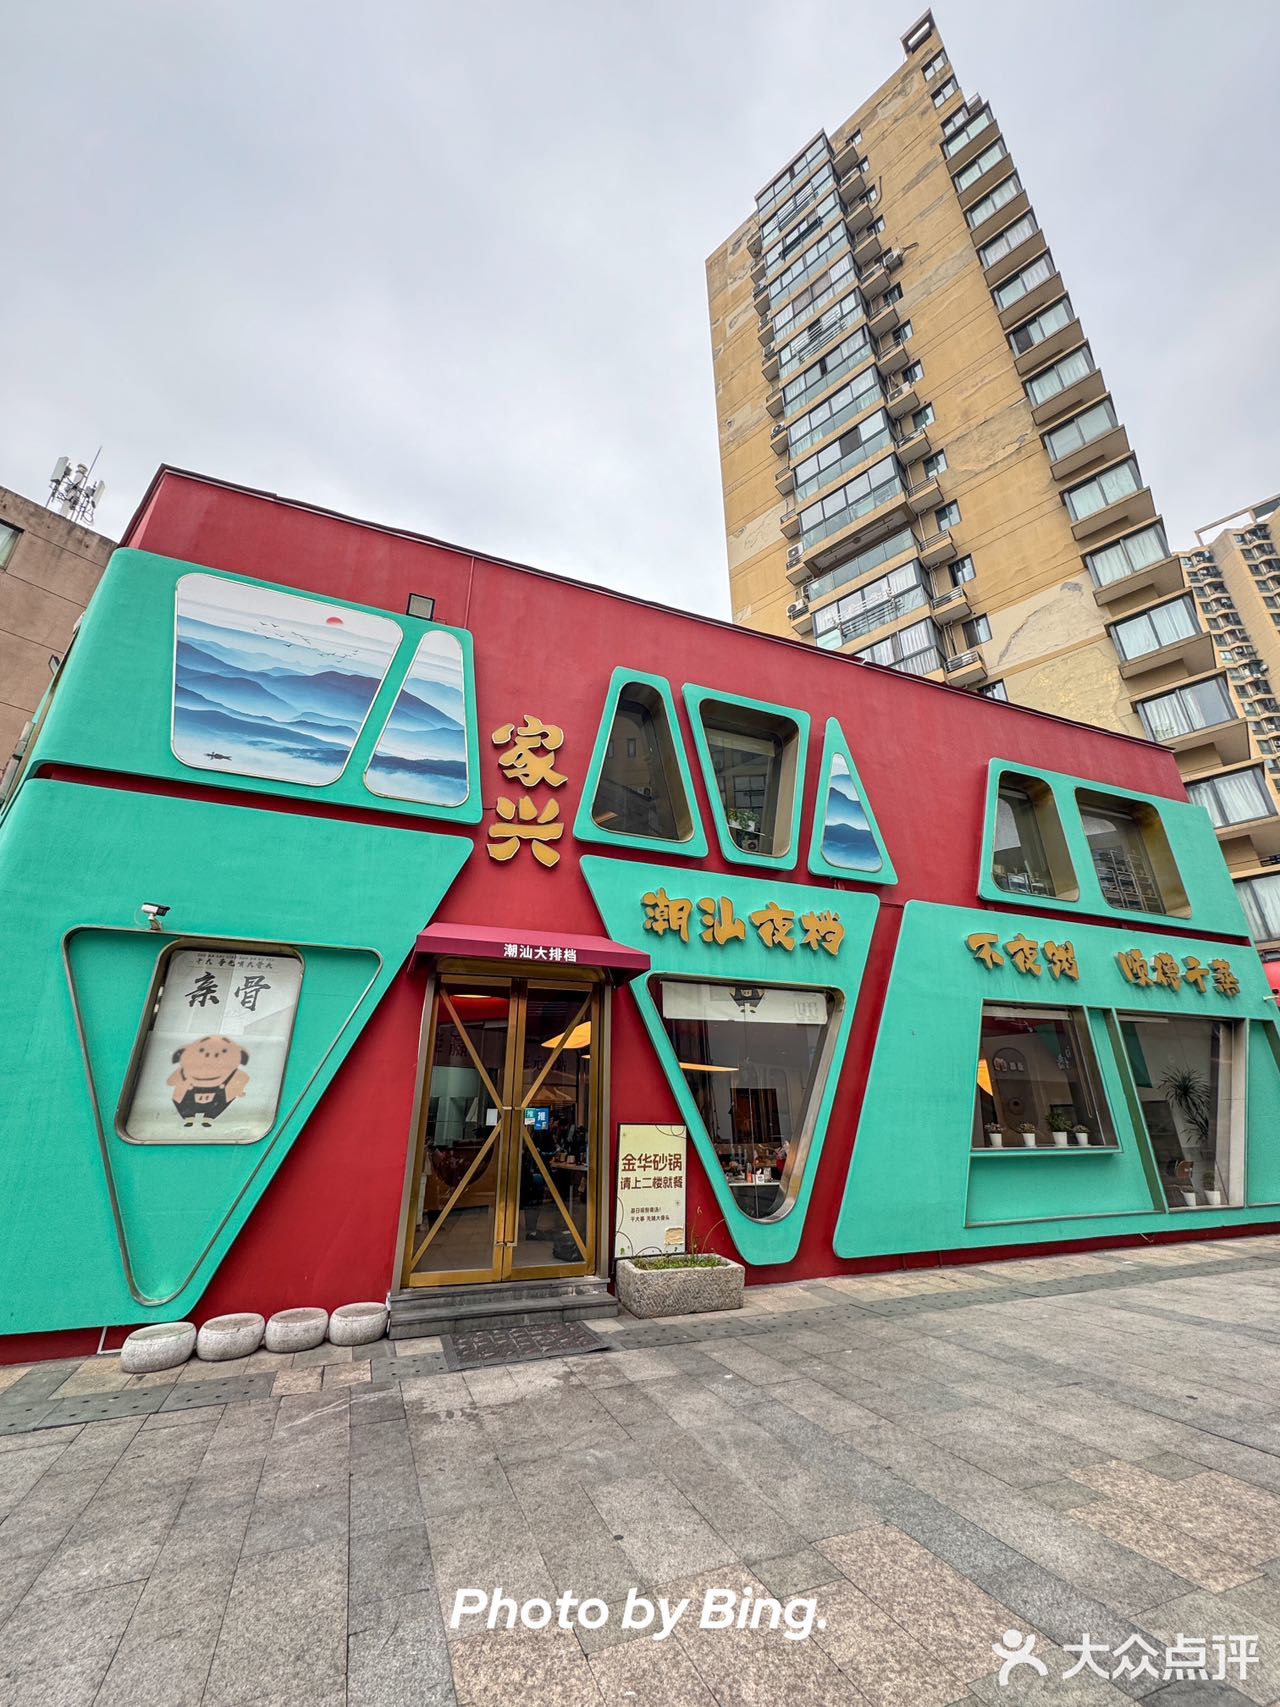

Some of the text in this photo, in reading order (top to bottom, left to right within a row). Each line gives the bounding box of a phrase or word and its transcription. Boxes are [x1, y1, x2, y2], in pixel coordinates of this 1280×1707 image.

[487, 713, 569, 868] 家兴
[640, 887, 847, 958] 潮汕夜档
[503, 943, 577, 963] 潮汕大排档
[966, 933, 1080, 983] 不夜粥
[621, 1153, 682, 1172] 金华砂锅
[620, 1176, 683, 1190] 请上二楼就餐
